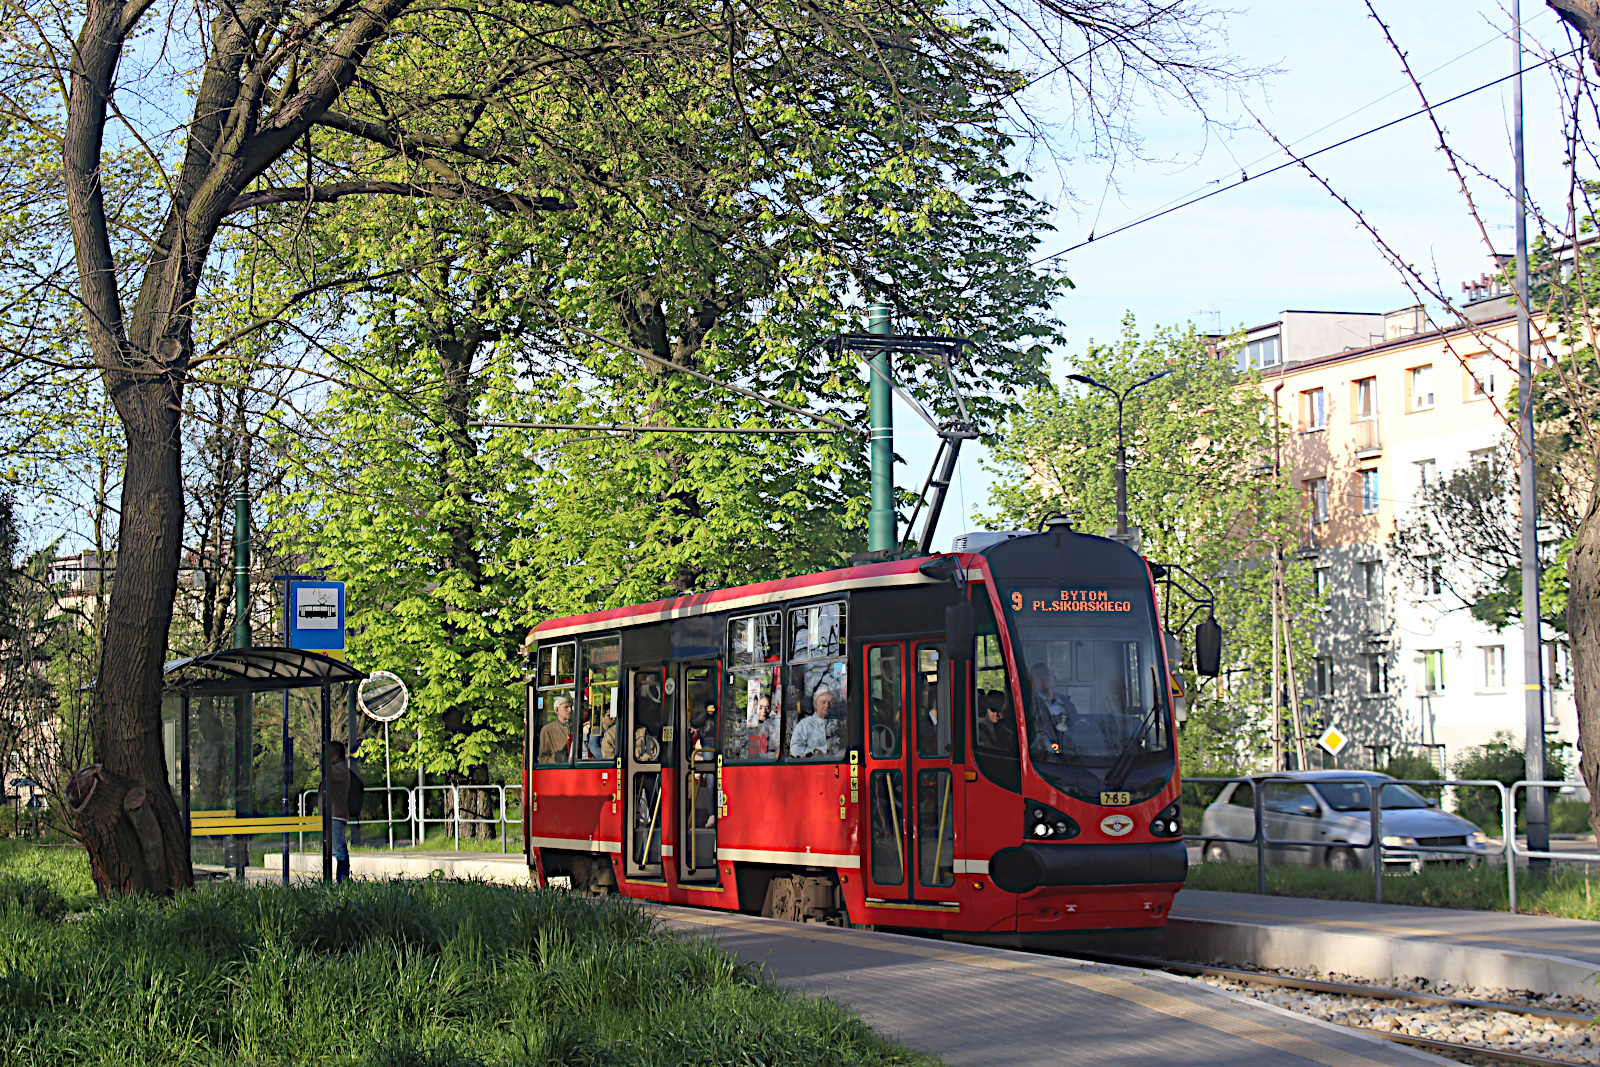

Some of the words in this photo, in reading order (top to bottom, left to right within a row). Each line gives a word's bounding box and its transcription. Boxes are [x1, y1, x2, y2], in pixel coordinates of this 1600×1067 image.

[1011, 591, 1023, 611] 9
[1060, 590, 1108, 601] BYTOM
[1032, 600, 1131, 612] PL.SIKORSKIEGO
